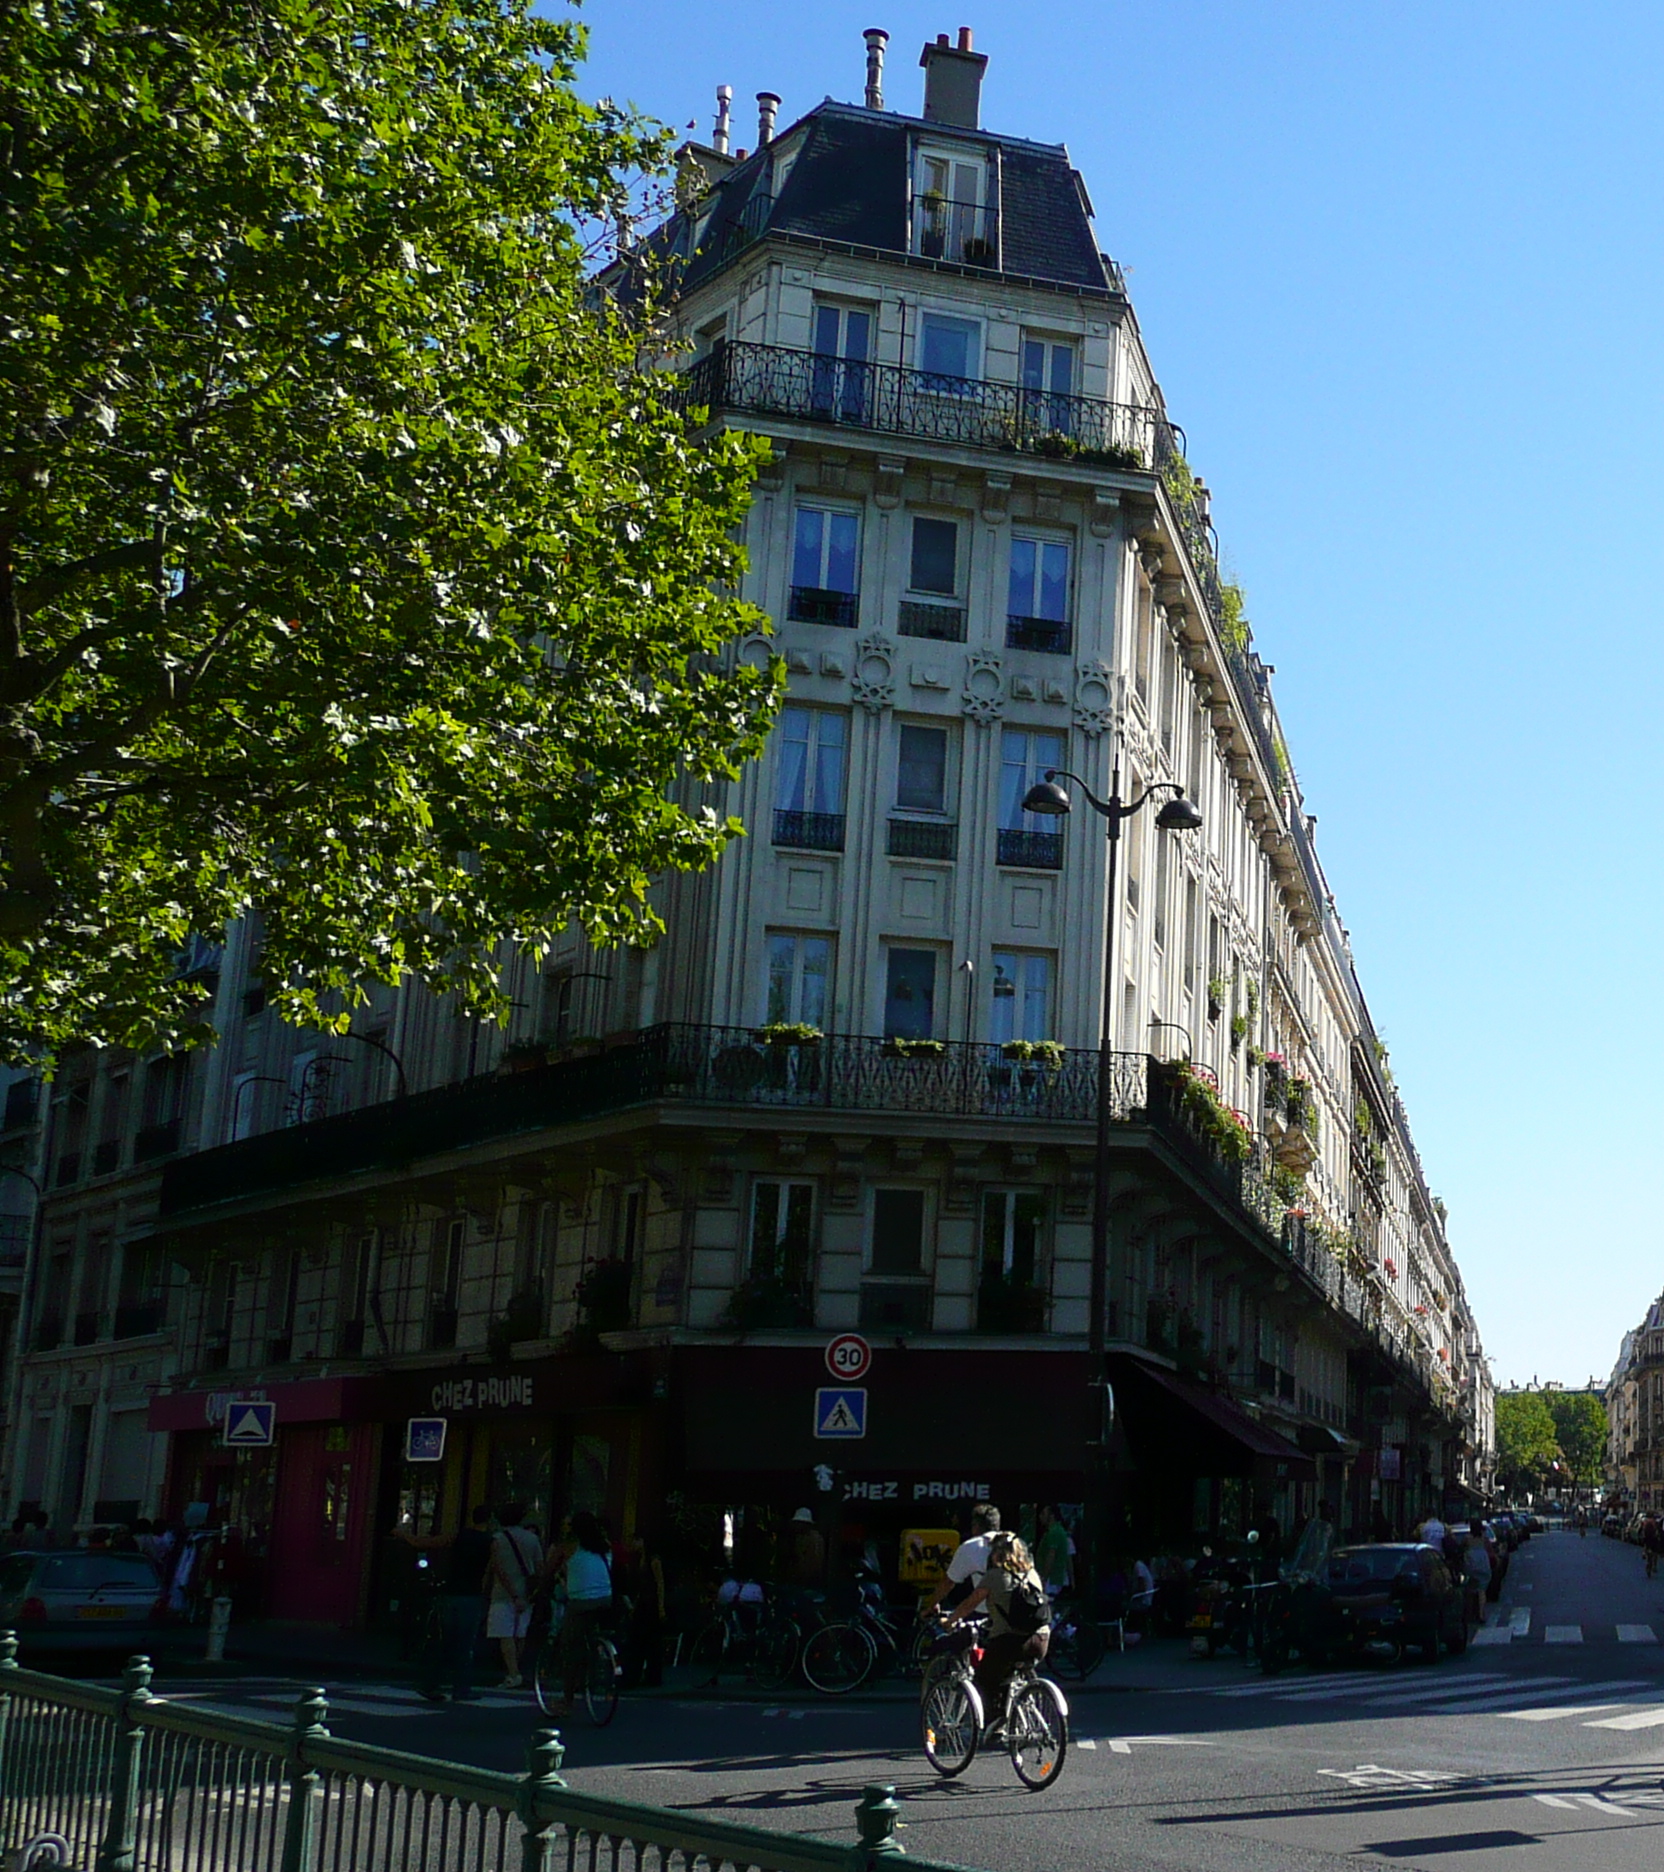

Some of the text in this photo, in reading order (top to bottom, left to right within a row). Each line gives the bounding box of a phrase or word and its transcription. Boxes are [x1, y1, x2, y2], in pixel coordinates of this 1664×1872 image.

[836, 1347, 862, 1367] 30
[431, 1374, 533, 1412] CHEZ PRUNE
[912, 1480, 991, 1502] PRUNE
